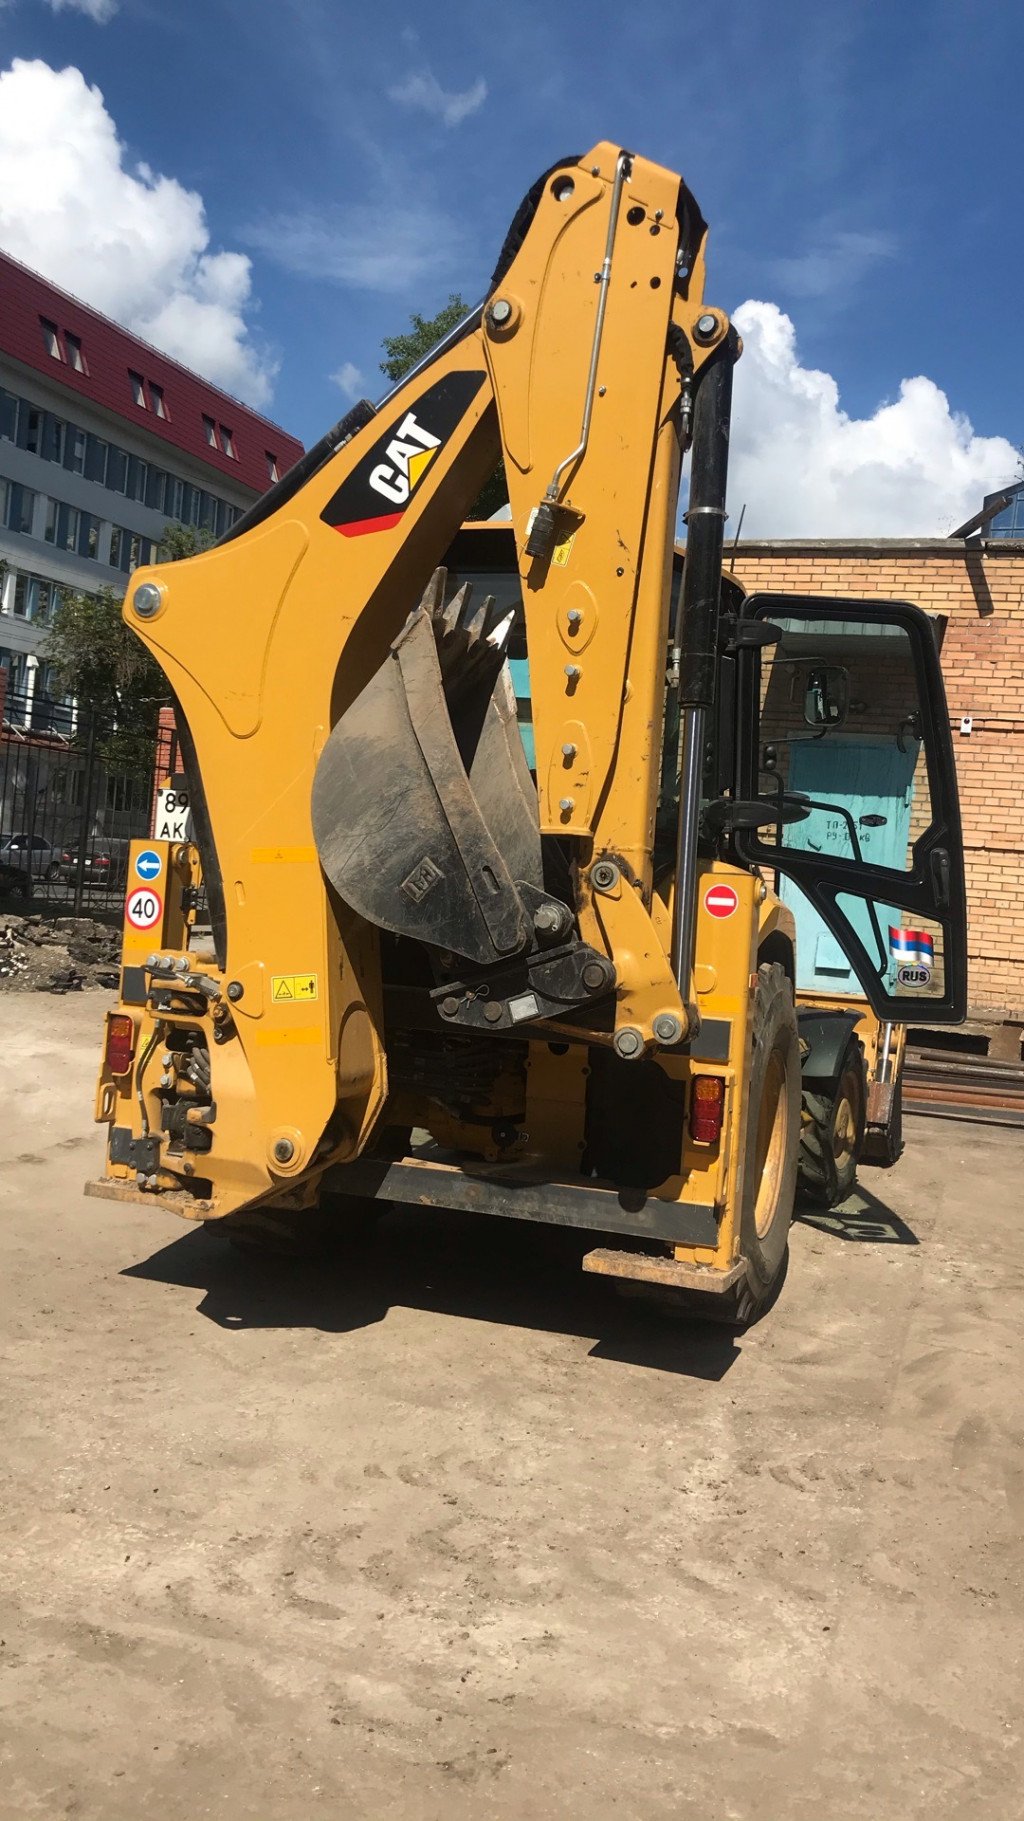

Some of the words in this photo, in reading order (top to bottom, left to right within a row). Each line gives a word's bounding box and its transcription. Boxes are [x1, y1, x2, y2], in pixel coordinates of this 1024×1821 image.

[369, 412, 442, 504] CAT
[132, 898, 155, 918] 40
[902, 971, 927, 981] RUS
